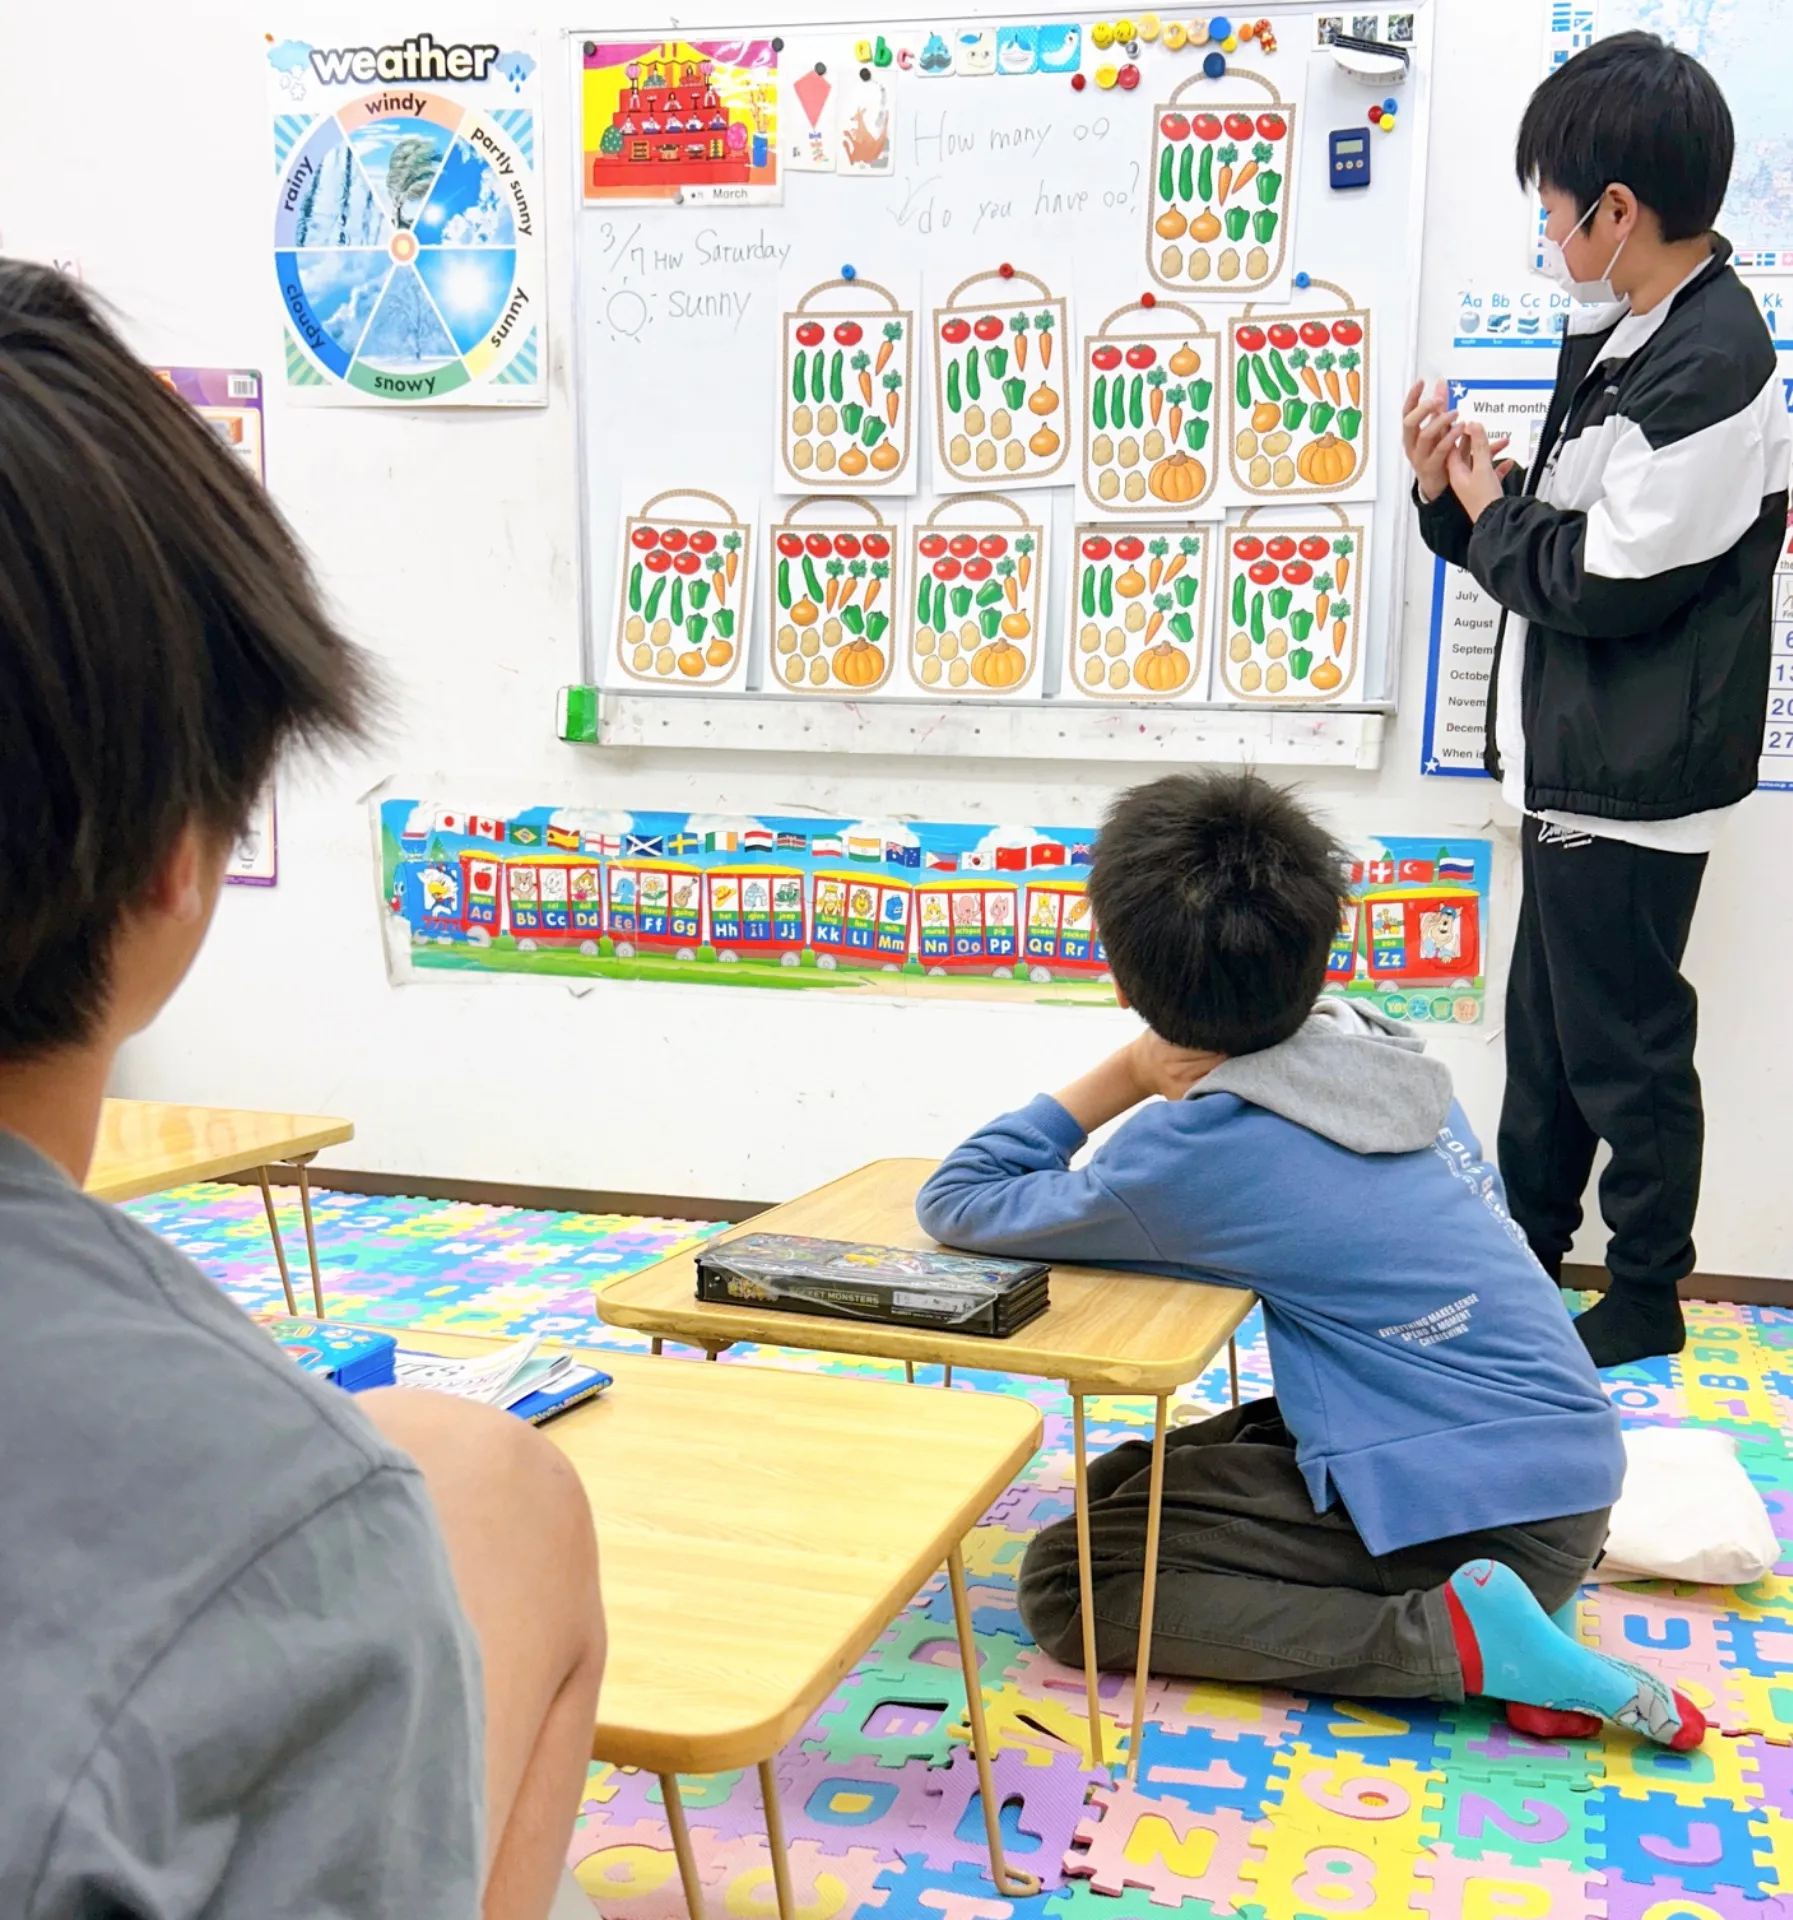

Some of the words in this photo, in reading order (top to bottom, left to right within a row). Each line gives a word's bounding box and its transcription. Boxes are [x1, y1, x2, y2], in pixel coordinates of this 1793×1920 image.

[310, 33, 498, 84] weather
[365, 92, 427, 116] windy
[914, 110, 974, 166] How
[990, 124, 1052, 159] many
[284, 156, 313, 212] rainy
[470, 127, 513, 177] partly
[509, 180, 533, 237] sunny
[713, 188, 748, 199] March
[918, 196, 951, 234] do
[972, 200, 1013, 235] you
[1034, 178, 1089, 216] have
[654, 250, 684, 270] HW
[695, 229, 791, 270] Saturday
[1461, 291, 1483, 308] Aa
[1491, 292, 1510, 308] Bb
[1520, 292, 1541, 308] Cc
[1549, 292, 1571, 308] Dd
[1762, 292, 1783, 308] Kk
[286, 283, 326, 350] cloudy
[490, 286, 529, 348] sunny
[374, 376, 436, 394] snowy
[1473, 402, 1504, 414] What
[1487, 430, 1512, 440] uary
[1456, 591, 1479, 603] July
[1454, 618, 1493, 630] August
[1452, 643, 1494, 655] Septem
[1450, 670, 1490, 681] Octobe
[1448, 697, 1486, 707] Novem
[1446, 723, 1485, 733] Decem
[1442, 748, 1473, 759] When
[470, 908, 493, 922] Aa
[515, 911, 538, 926] Bb
[545, 912, 567, 927] Cc
[575, 912, 598, 927] Dd
[614, 914, 633, 930] Ee
[644, 917, 663, 931] Ff
[672, 919, 697, 936] Gg
[715, 924, 738, 937] Hh
[750, 923, 764, 937] Ii
[780, 923, 796, 940] Jj
[817, 925, 840, 942] Kk
[852, 930, 868, 946] Ll
[878, 934, 905, 951] Mm
[924, 939, 948, 953] Nn
[956, 938, 981, 953] Oo
[989, 938, 1012, 955] Pp
[1028, 938, 1055, 956] Qq
[1065, 941, 1086, 957] Rr
[1378, 951, 1401, 967] Zz
[828, 1290, 879, 1306] MONSTERS
[1378, 1316, 1430, 1338] EVERYTHING
[1427, 1303, 1456, 1324] MAKES
[1452, 1292, 1479, 1312] SENSE
[1401, 1327, 1430, 1342] SPEND
[1430, 1324, 1438, 1334] A
[1437, 1309, 1472, 1332] MOMENT
[1418, 1323, 1470, 1347] CHERISHING
[1147, 1759, 1247, 1789] 1
[1457, 1782, 1570, 1834] 2
[1292, 1834, 1378, 1913] 8
